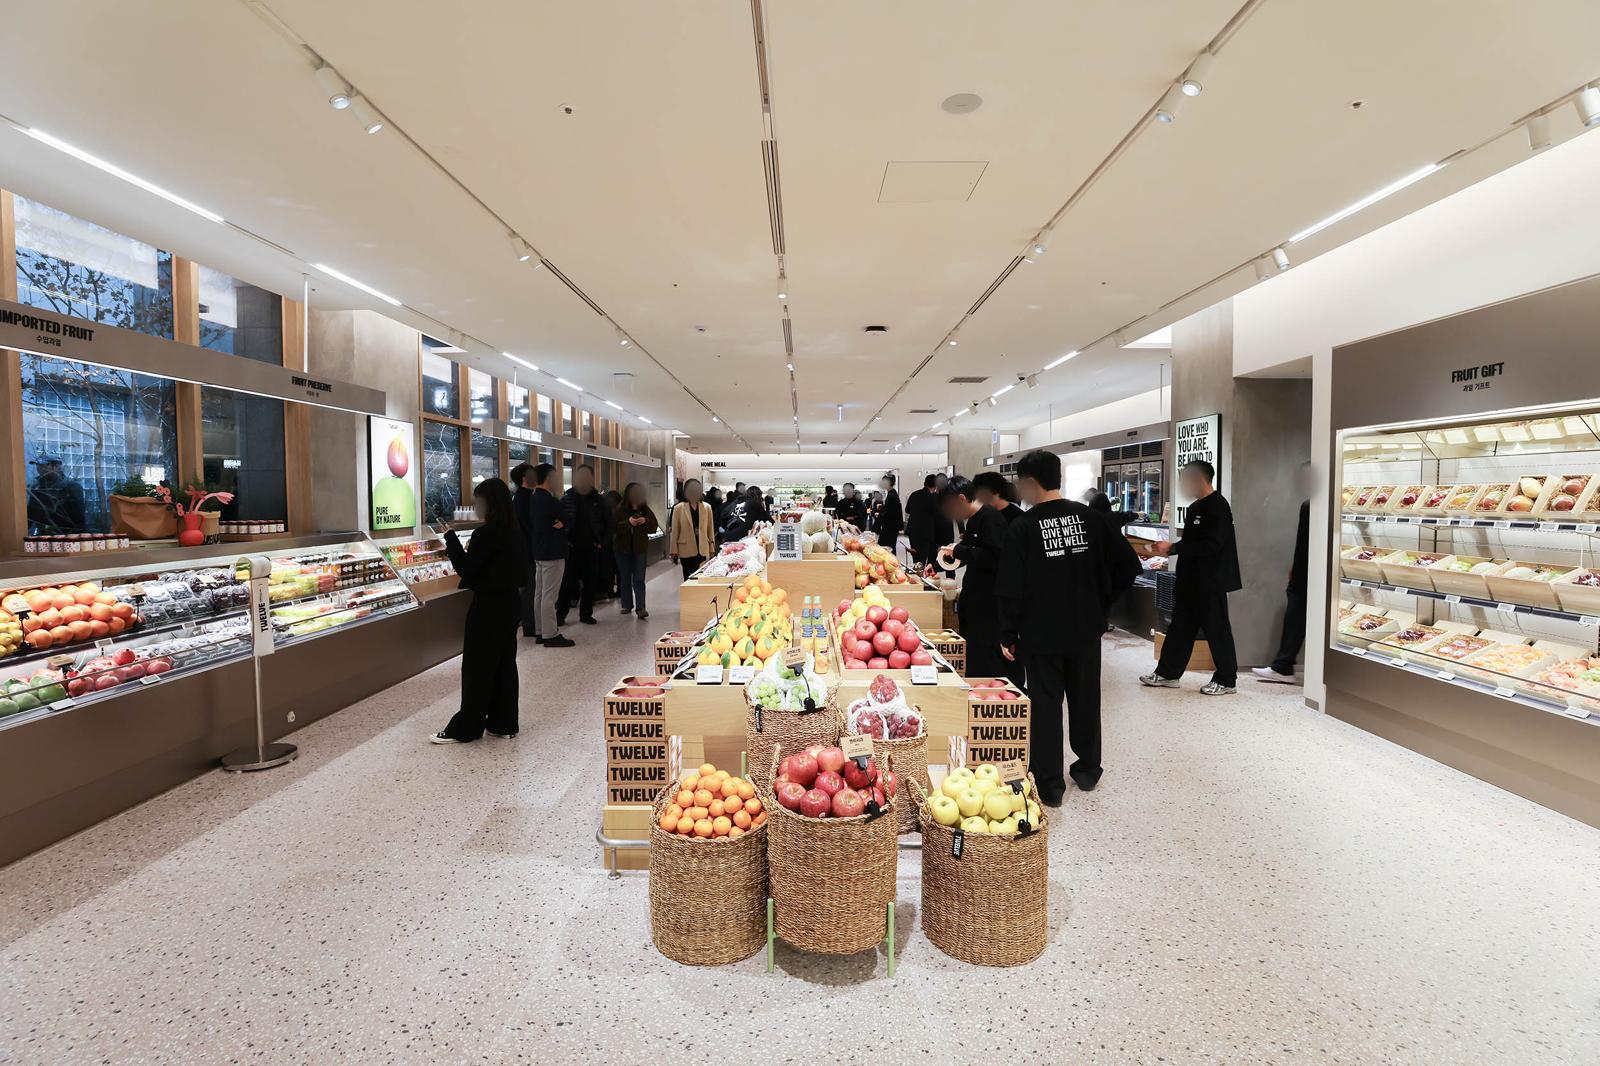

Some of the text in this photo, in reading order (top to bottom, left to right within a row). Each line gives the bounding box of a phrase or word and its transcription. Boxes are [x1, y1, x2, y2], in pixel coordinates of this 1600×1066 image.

[62, 323, 94, 341] FRUIT
[1451, 361, 1505, 383] FRUIT GIFT
[1178, 421, 1209, 440] LOVE WHO
[1178, 437, 1209, 453] YOU ARE.
[1178, 454, 1186, 468] BE
[1205, 450, 1213, 462] TO
[376, 506, 388, 516] PURE
[376, 514, 401, 525] BY NATURE
[1038, 514, 1085, 530] LOVE WELL.
[1041, 524, 1087, 540] GIVE WELL.
[1043, 537, 1064, 550] LIVE
[1063, 534, 1089, 547] WELL.
[258, 602, 269, 633] TWELVE
[607, 701, 663, 716] TWELVE
[971, 704, 1028, 719] TWELVE
[608, 723, 663, 738] TWELVE
[970, 726, 1027, 741] TWELVE
[609, 745, 666, 760] TWELVE
[969, 747, 1026, 762] TWELVE
[610, 767, 666, 781] TWELVE
[610, 788, 662, 803] TWELV
